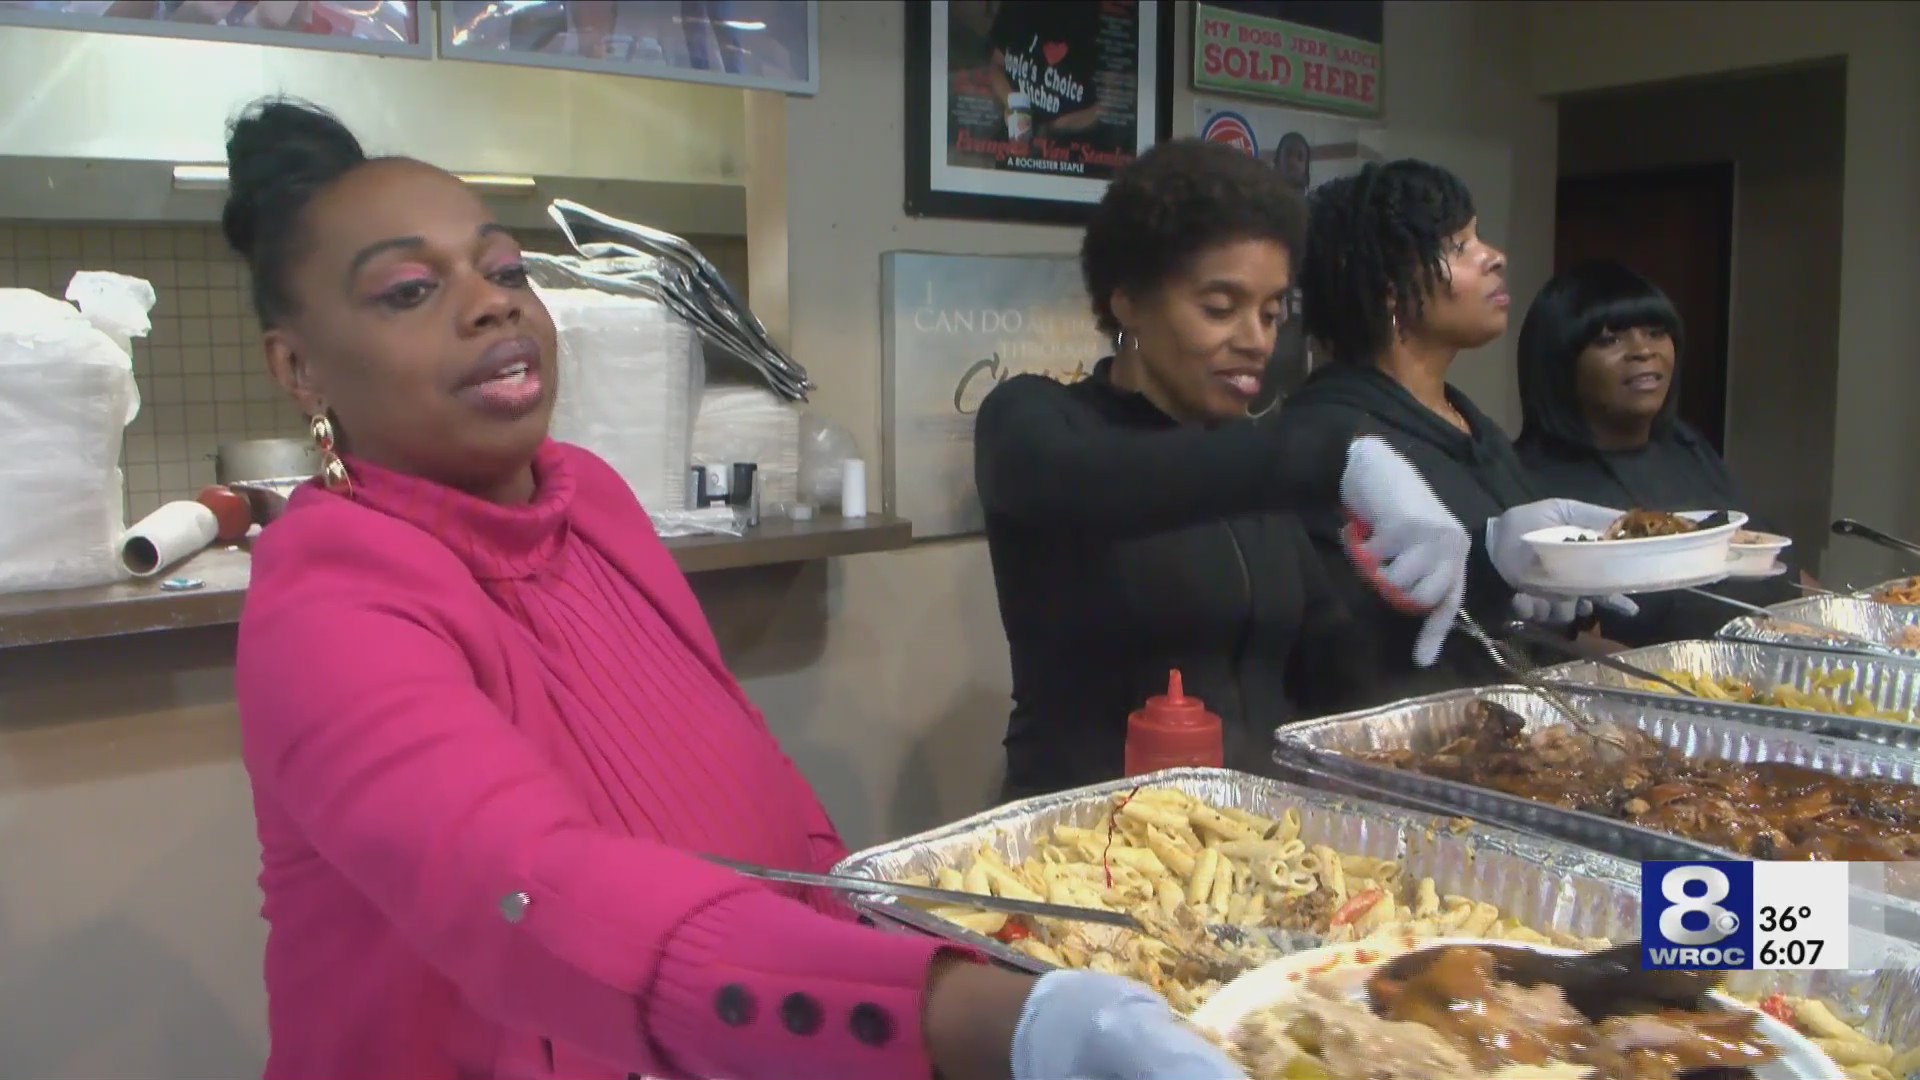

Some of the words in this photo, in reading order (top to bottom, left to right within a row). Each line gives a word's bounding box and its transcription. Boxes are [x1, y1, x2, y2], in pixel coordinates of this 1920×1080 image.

[1203, 18, 1231, 39] MY
[1238, 25, 1282, 48] BOSS
[1290, 36, 1329, 58] JERK
[1044, 66, 1084, 103] Choice
[1204, 43, 1292, 85] SOLD
[1303, 61, 1377, 103] HERE
[1007, 156, 1014, 167] A
[1015, 157, 1058, 171] ROCHESTER
[1060, 160, 1085, 174] STAPLE
[914, 308, 974, 334] CAN
[981, 308, 1023, 334] DO
